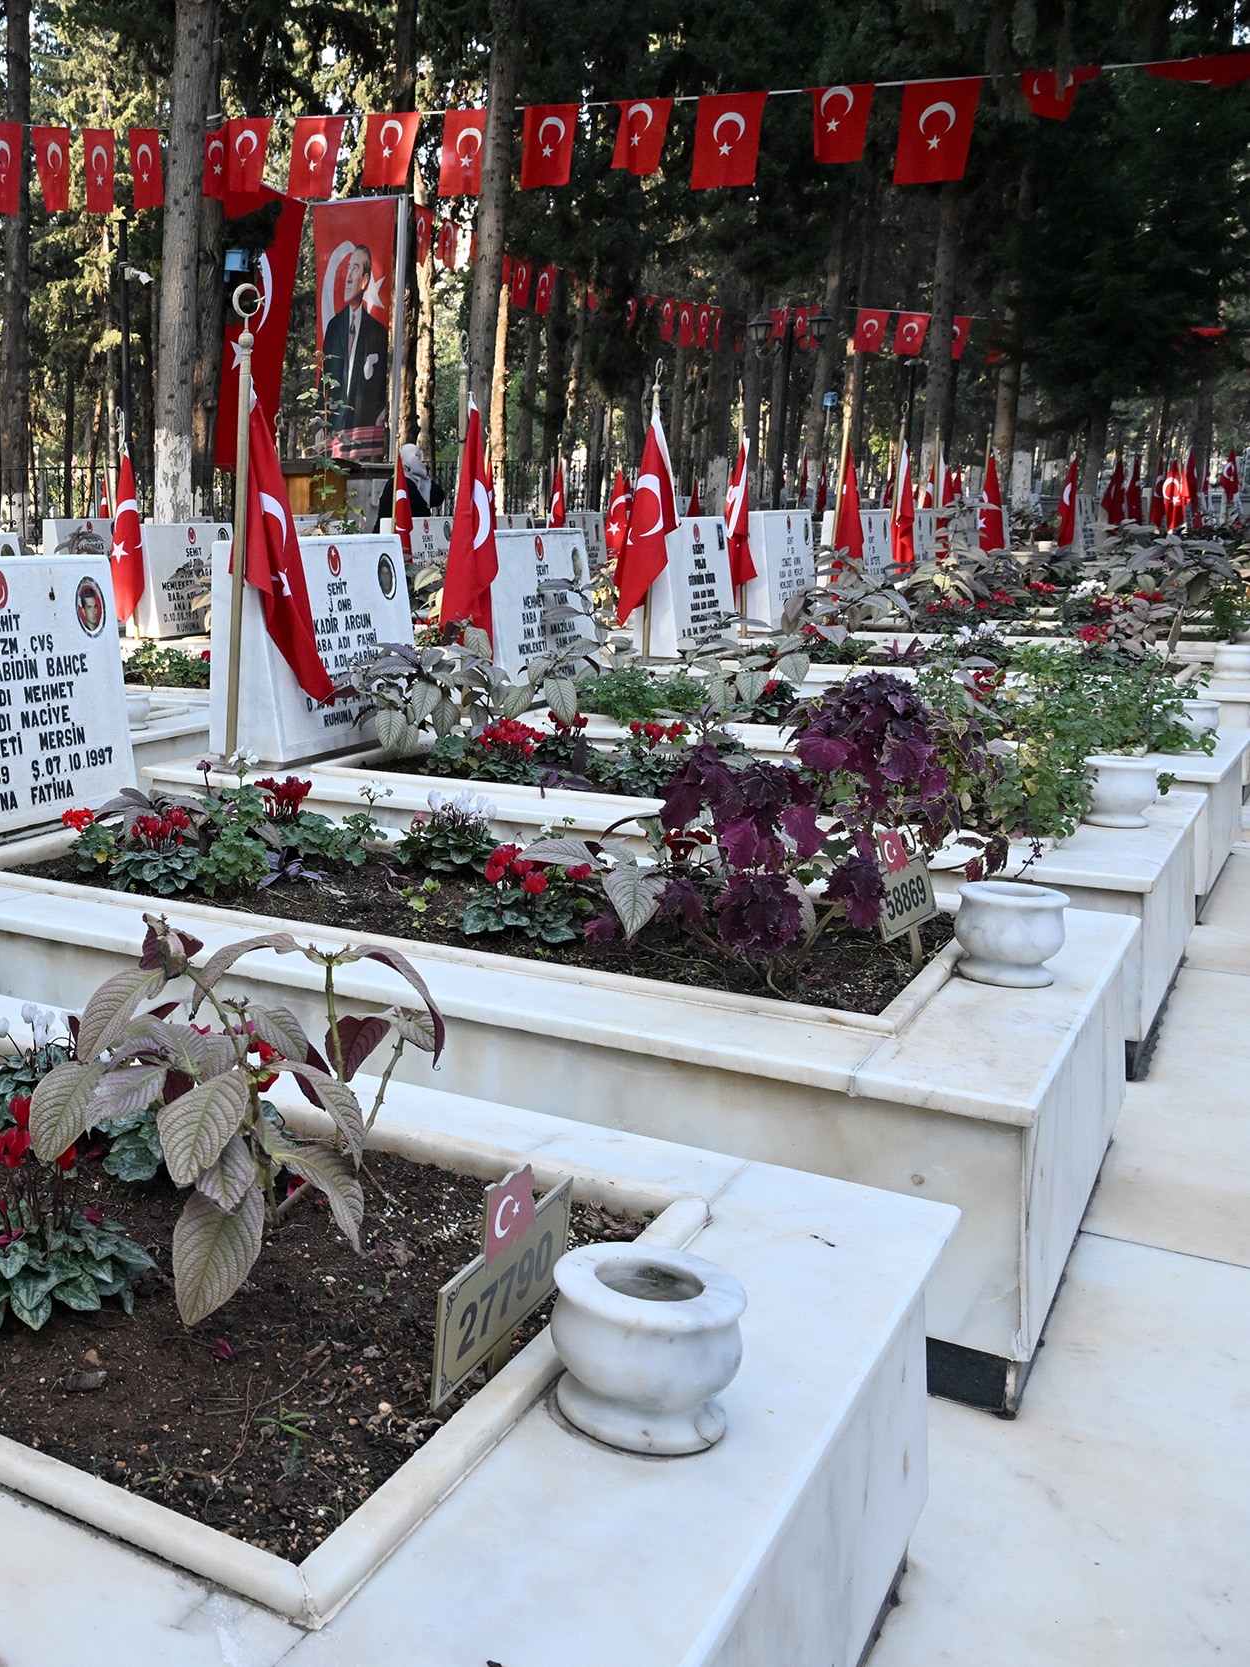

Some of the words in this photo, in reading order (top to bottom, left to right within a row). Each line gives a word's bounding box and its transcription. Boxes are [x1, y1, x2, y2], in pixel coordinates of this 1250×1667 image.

[327, 578, 347, 596] ŞEHİT
[176, 621, 201, 632] RUHUNA
[313, 614, 339, 635] KADİR
[345, 613, 372, 632] ARGUN
[522, 611, 537, 625] BABA
[30, 634, 54, 655] ÇVŞ
[317, 638, 333, 652] ABA
[338, 636, 351, 650] ADI
[357, 628, 378, 647] FAHRİ
[523, 628, 534, 640] ANA
[46, 653, 89, 678] BAHÇE
[24, 681, 75, 704] MEHMET
[20, 702, 72, 730] NACİYE
[323, 709, 354, 728] RUHUNA
[39, 721, 86, 752] MERSİN
[30, 776, 75, 806] FATİHA
[885, 875, 927, 921] 58869
[457, 1230, 554, 1361] 27790
